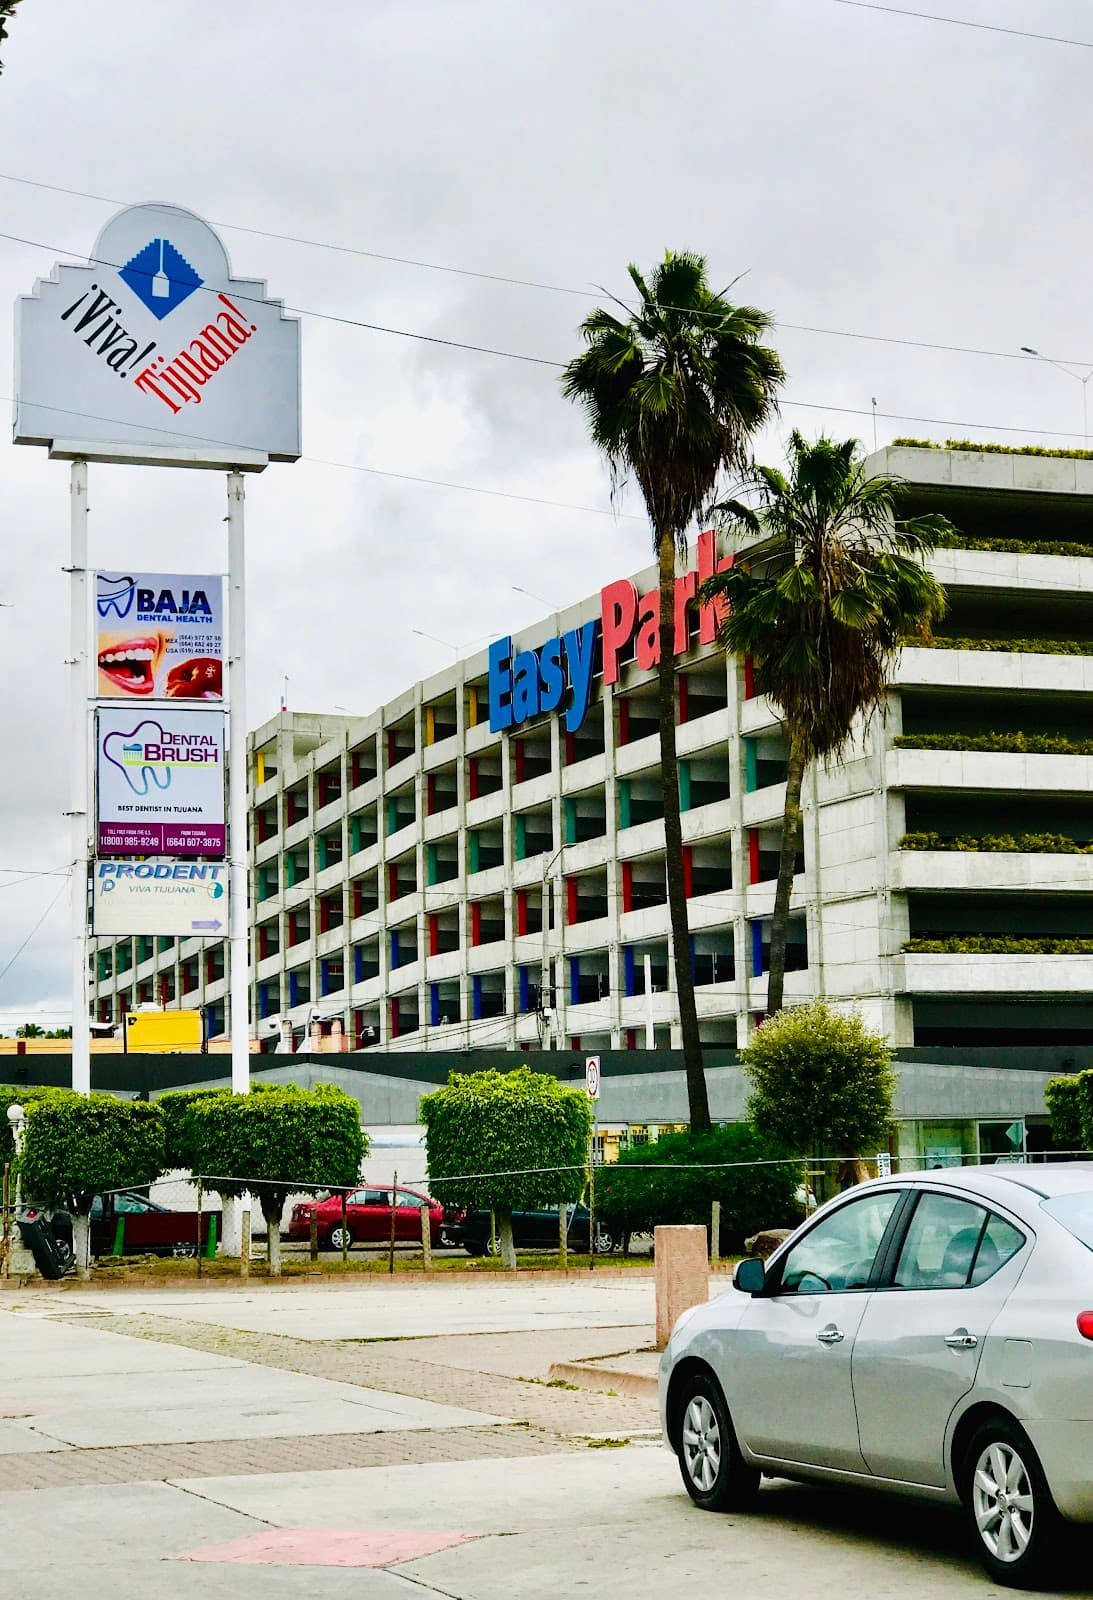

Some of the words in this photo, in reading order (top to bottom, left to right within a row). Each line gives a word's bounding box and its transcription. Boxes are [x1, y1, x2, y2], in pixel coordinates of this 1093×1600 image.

[61, 283, 157, 379] ¡Viva!
[134, 293, 258, 415] Tijuana!
[136, 588, 213, 615] BAJA
[136, 614, 174, 622] DENTAL
[176, 615, 213, 624] HEALTH
[488, 620, 599, 734] Easy
[160, 731, 218, 746] DENTAL
[144, 743, 218, 763] BRUSH
[166, 837, 186, 847] (664)
[98, 863, 225, 880] PRODENT
[129, 885, 151, 893] VIVA
[154, 886, 196, 894] TIJUANA
